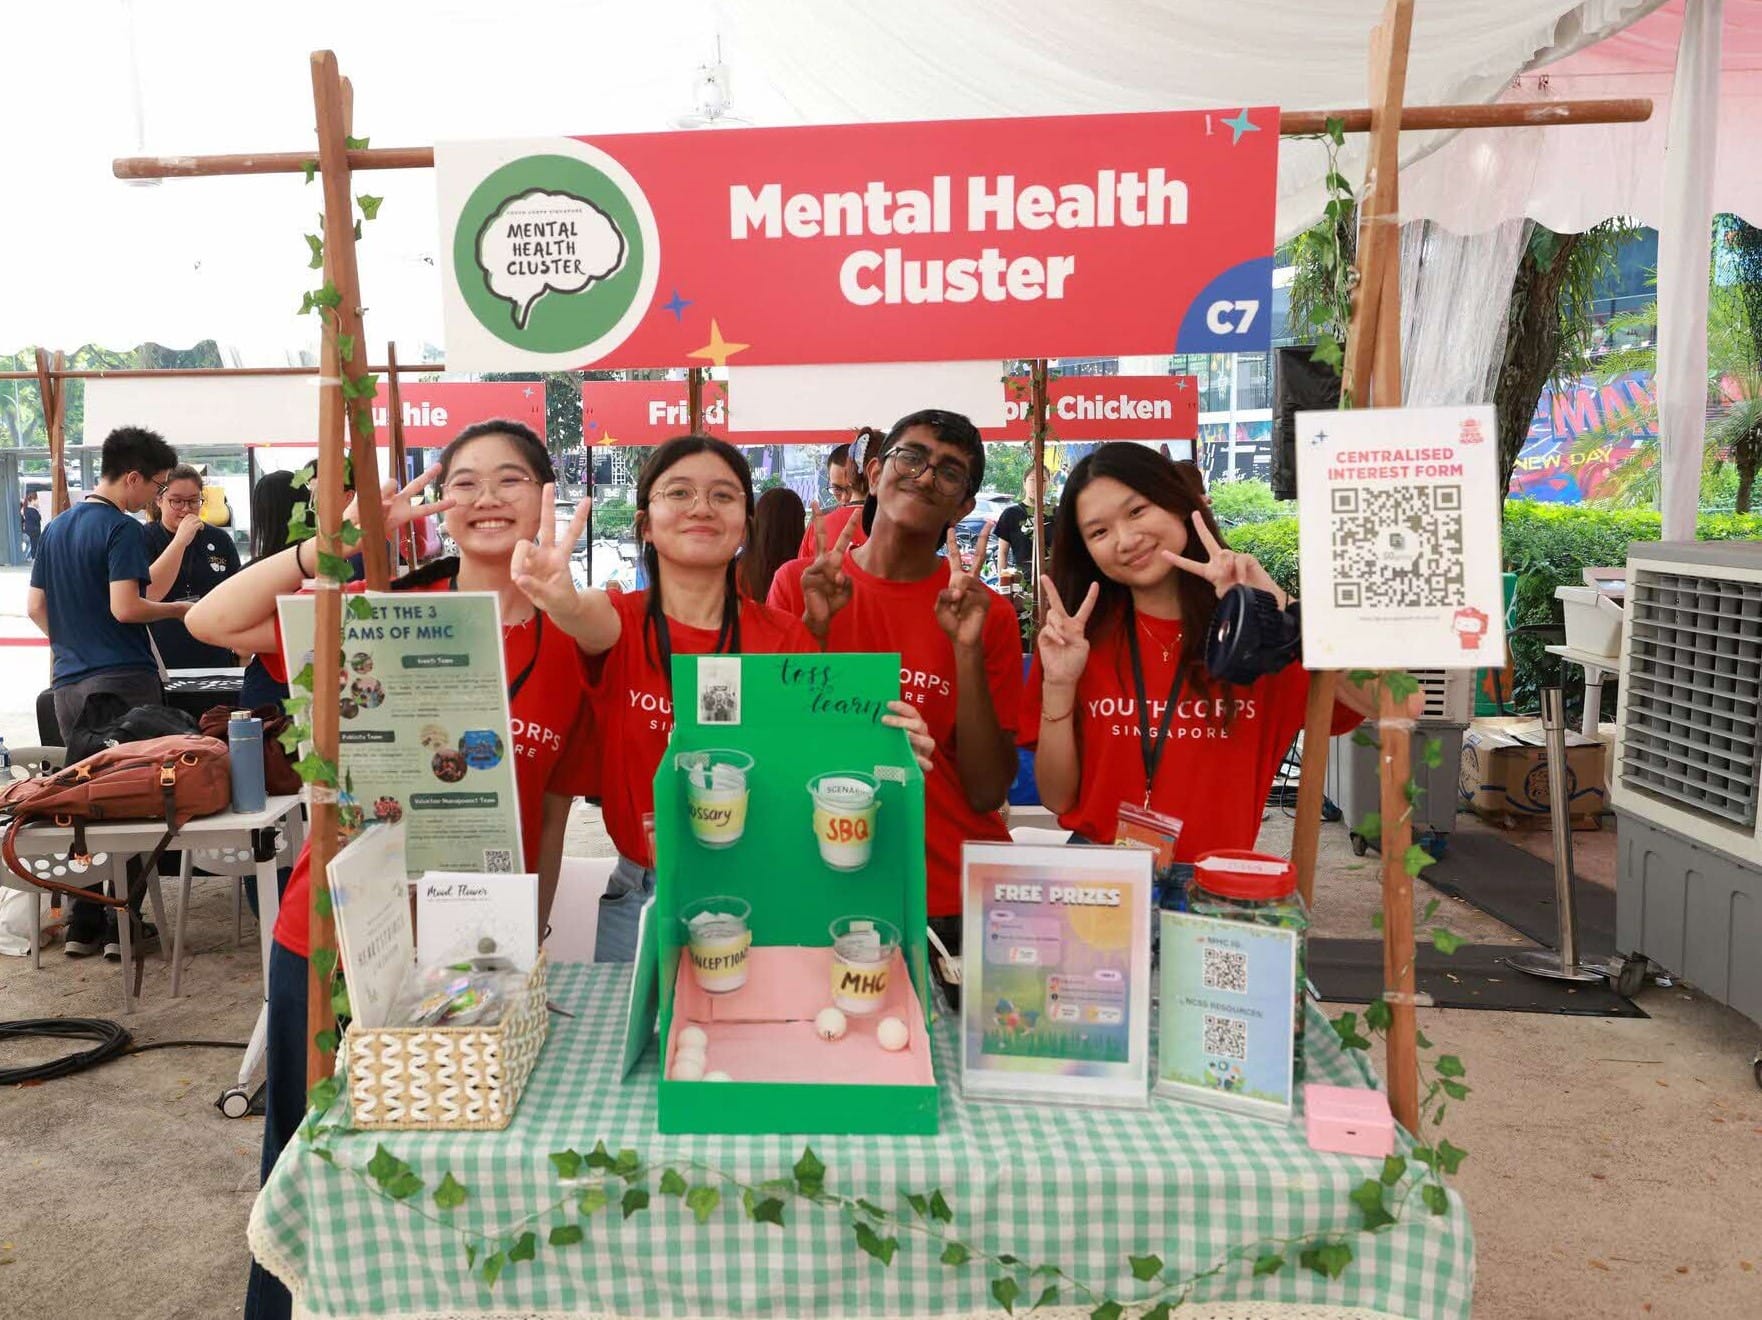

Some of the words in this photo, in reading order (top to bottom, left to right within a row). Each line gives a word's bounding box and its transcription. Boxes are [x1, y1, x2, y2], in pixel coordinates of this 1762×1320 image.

[729, 179, 951, 240] Mental
[966, 167, 1189, 236] Health
[507, 221, 578, 239] MENTAL
[512, 240, 576, 258] HEALTH
[506, 259, 586, 275] CLUSTER
[838, 249, 1075, 306] Cluster
[1206, 299, 1260, 335] C7
[371, 401, 448, 427] uhie
[649, 400, 725, 425] Frid
[1057, 394, 1173, 421] Chicken
[1336, 447, 1455, 464] CENTRALISED
[1514, 454, 1561, 470] NEW
[1570, 445, 1613, 466] DAY
[1328, 465, 1409, 480] INTEREST
[1415, 463, 1463, 478] FORM
[346, 606, 387, 620] MET
[394, 606, 423, 620] THE
[428, 606, 437, 619] 3
[341, 626, 384, 640] AMS
[390, 626, 411, 640] OF
[417, 625, 454, 640] MHC
[630, 690, 673, 714] YOU
[811, 692, 882, 724] learn
[688, 804, 732, 827] ossary
[826, 818, 869, 843] SBQ
[457, 883, 489, 897] Flower
[995, 884, 1043, 903] FREE
[1049, 886, 1121, 907] PRIZES
[841, 972, 888, 995] MHC
